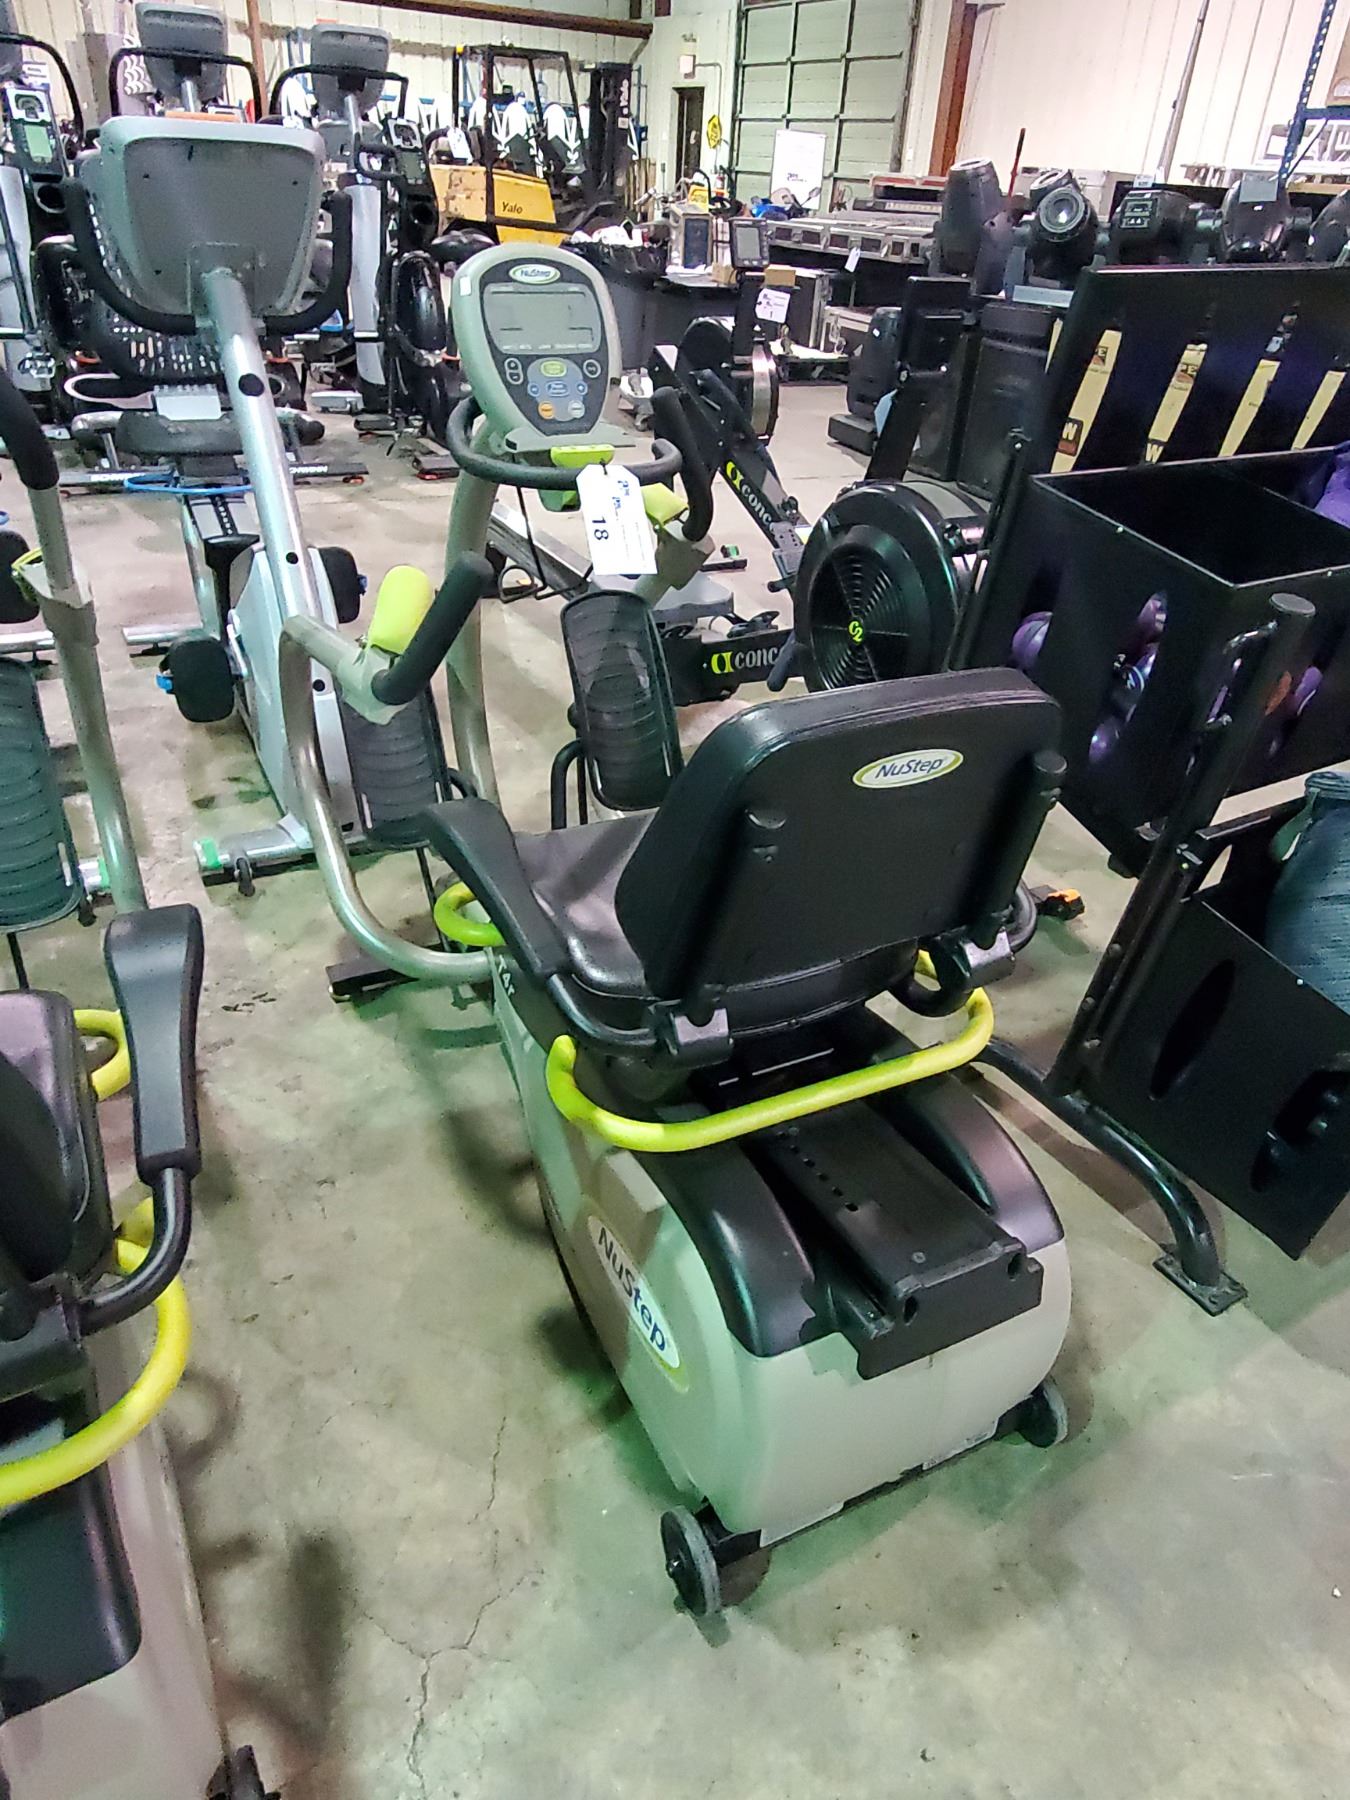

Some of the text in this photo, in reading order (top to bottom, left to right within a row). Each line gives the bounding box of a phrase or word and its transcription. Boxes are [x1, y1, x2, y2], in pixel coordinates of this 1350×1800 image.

[592, 515, 609, 541] 18
[875, 759, 943, 779] NuStep
[598, 1226, 666, 1352] NuStep
